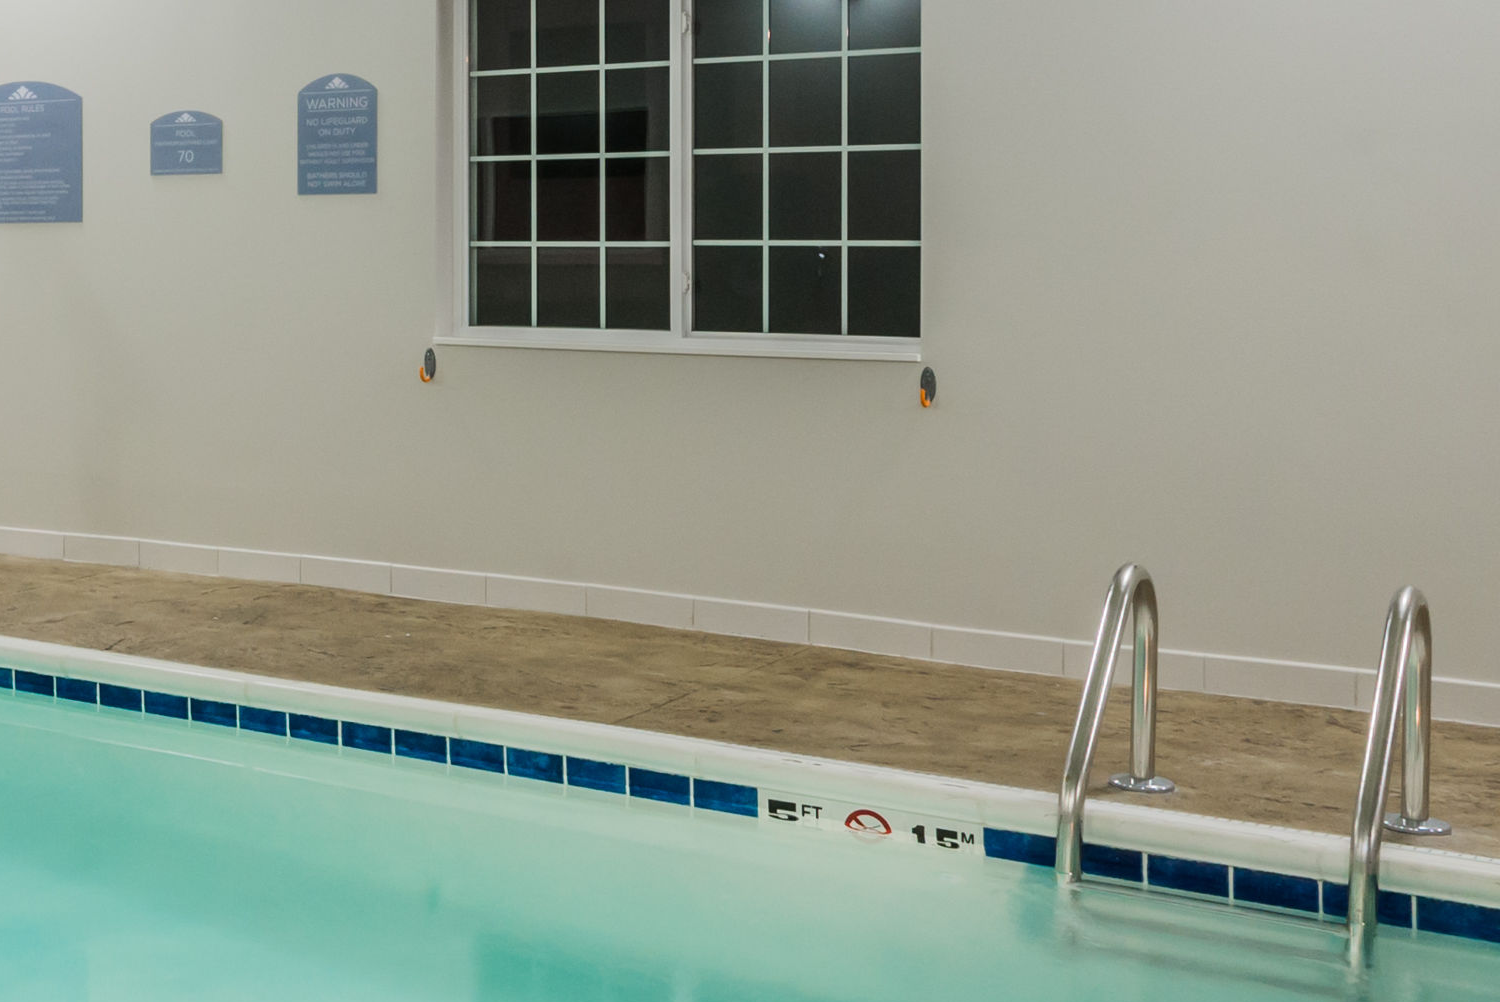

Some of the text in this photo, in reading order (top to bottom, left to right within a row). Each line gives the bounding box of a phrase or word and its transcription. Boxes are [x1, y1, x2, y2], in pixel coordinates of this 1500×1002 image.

[306, 96, 368, 110] WARNING
[306, 116, 368, 127] NO LIFEGUARD
[318, 127, 356, 137] ON DUTY
[177, 149, 195, 163] 70
[801, 804, 823, 820] FT
